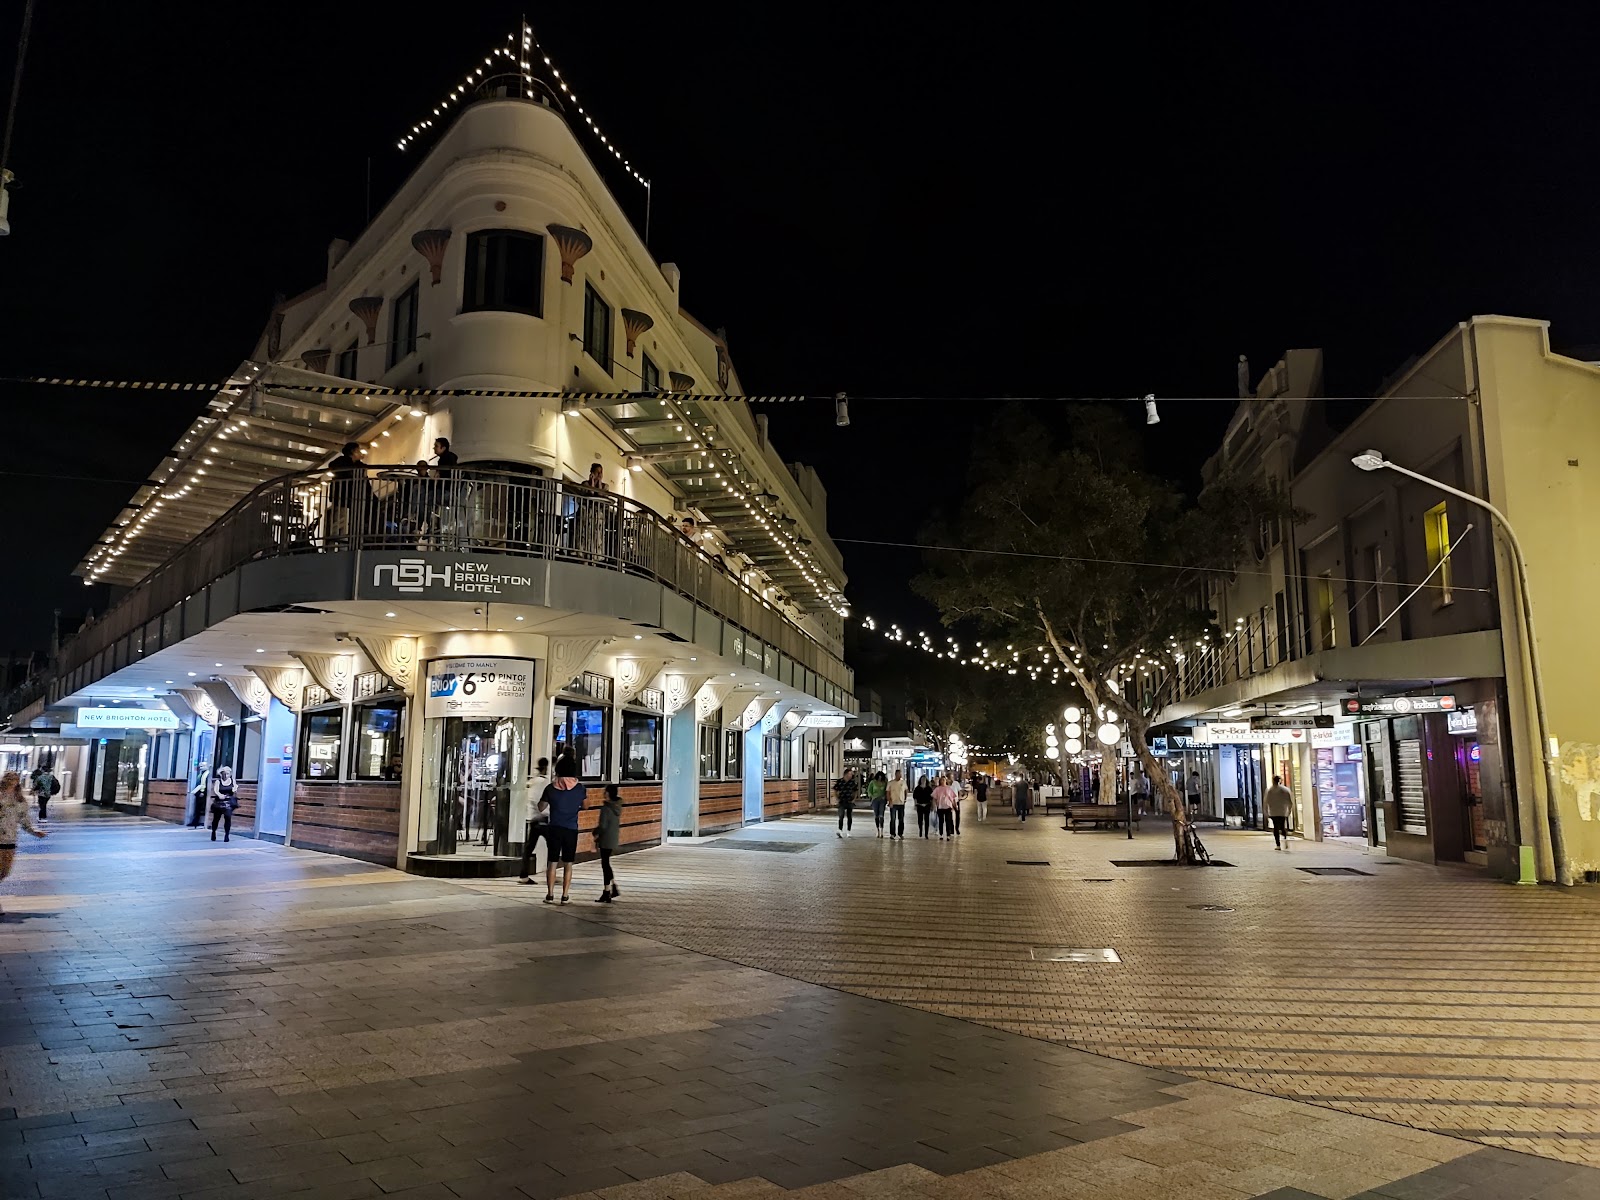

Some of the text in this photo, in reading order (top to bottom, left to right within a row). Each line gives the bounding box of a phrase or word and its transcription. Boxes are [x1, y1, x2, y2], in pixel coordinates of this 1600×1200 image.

[454, 562, 489, 572] NEW
[454, 572, 531, 586] BRIGHTON
[454, 583, 502, 594] HOTEL
[498, 673, 527, 682] PINT OF
[431, 678, 455, 692] ENJOY
[1211, 727, 1248, 735] Ser-Bar
